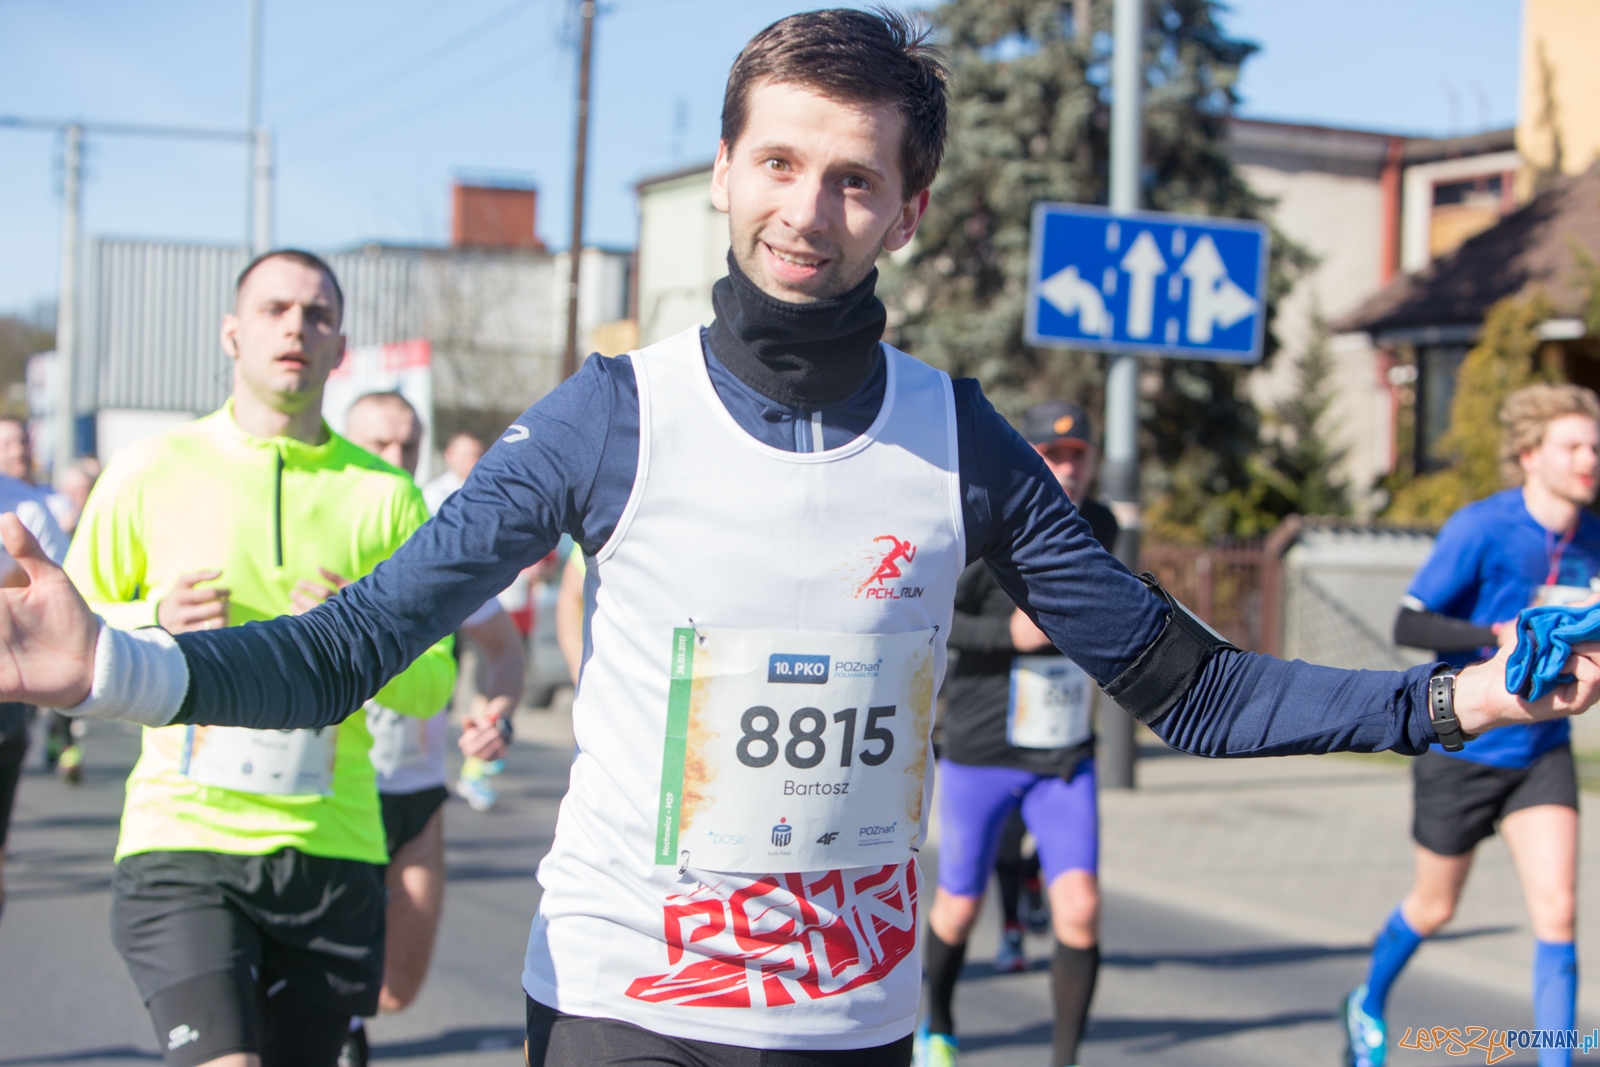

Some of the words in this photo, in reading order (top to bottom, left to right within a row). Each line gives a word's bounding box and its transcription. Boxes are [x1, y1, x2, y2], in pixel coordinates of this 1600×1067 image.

[866, 587, 924, 599] PCH_RUN
[676, 635, 687, 675] 26.03.2017
[774, 661, 792, 675] 10.
[794, 662, 825, 676] PKO
[736, 705, 896, 769] 8815
[784, 780, 849, 795] Bartosz
[665, 792, 674, 808] M29
[662, 815, 672, 856] Nochowicz
[816, 832, 839, 845] 4F
